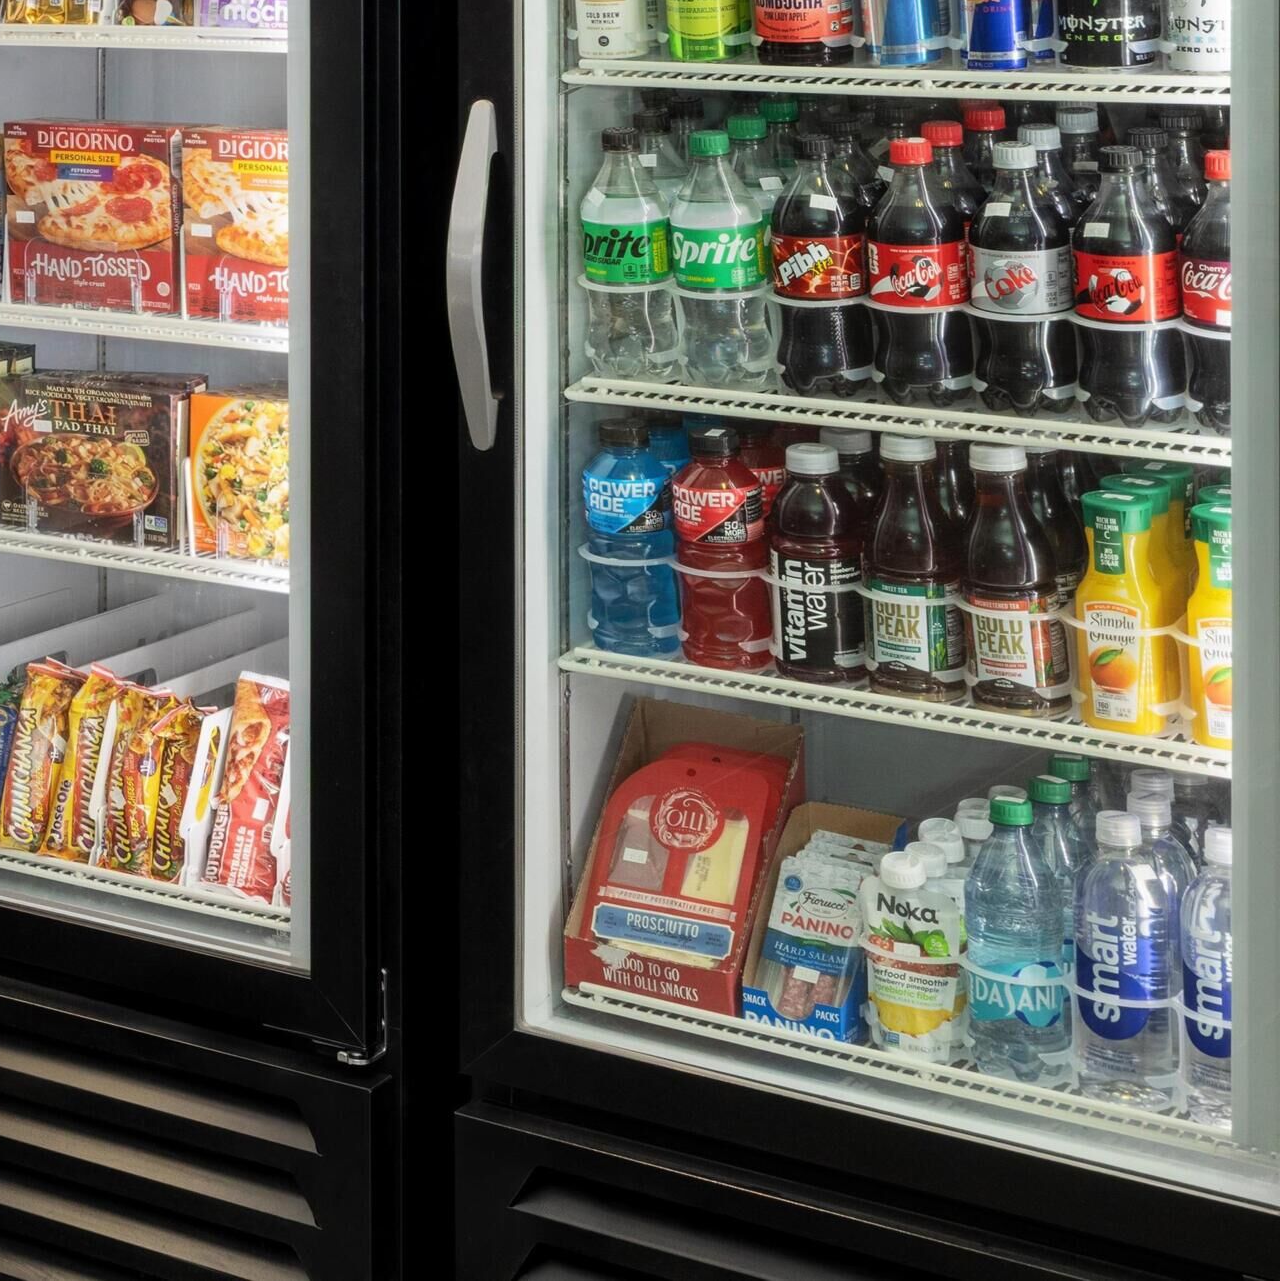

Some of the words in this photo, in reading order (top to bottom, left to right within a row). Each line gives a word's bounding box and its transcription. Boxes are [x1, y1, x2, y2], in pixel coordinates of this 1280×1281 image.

[1059, 15, 1145, 32] MONSTER
[1066, 33, 1135, 43] ENERGY
[55, 153, 93, 163] PERSONAL
[97, 154, 115, 163] SIZE
[672, 232, 756, 268] Sprite
[32, 253, 150, 281] HAND-TOSSED
[779, 243, 829, 284] Pibb
[1199, 264, 1227, 272] Cherry
[891, 258, 941, 296] Coca-Cola
[985, 265, 1038, 301] Coke
[3, 400, 47, 432] Amy's
[50, 402, 117, 425] THAI
[54, 420, 78, 433] PAD
[82, 423, 116, 435] THAI
[590, 481, 655, 497] POWER
[590, 498, 624, 513] ADE
[1096, 523, 1118, 531] VITAMIN
[804, 562, 826, 630] water
[781, 561, 803, 660] vitamin
[1090, 613, 1134, 630] Simply
[877, 618, 920, 638] PEAK
[9, 709, 39, 844] CHIMICHANGA
[667, 809, 703, 831] OLLI
[803, 892, 846, 911] Fiorucci
[878, 893, 938, 923] Noka
[627, 912, 699, 938] PROSCIUTTO
[782, 911, 853, 939] PANINO
[774, 941, 796, 955] HARD
[799, 949, 848, 964] SALAMI
[1123, 918, 1137, 965] water
[648, 963, 661, 977] TO
[664, 965, 679, 982] GO
[907, 971, 948, 987] smoothie
[1094, 914, 1121, 1022] smart
[603, 966, 631, 986] WITH
[634, 974, 656, 991] OLLI
[660, 980, 699, 1001] SNACKS
[907, 982, 938, 993] pineapple
[743, 992, 766, 1006] SNACK
[975, 984, 1059, 1015] DASANI
[816, 1010, 839, 1022] PACKS
